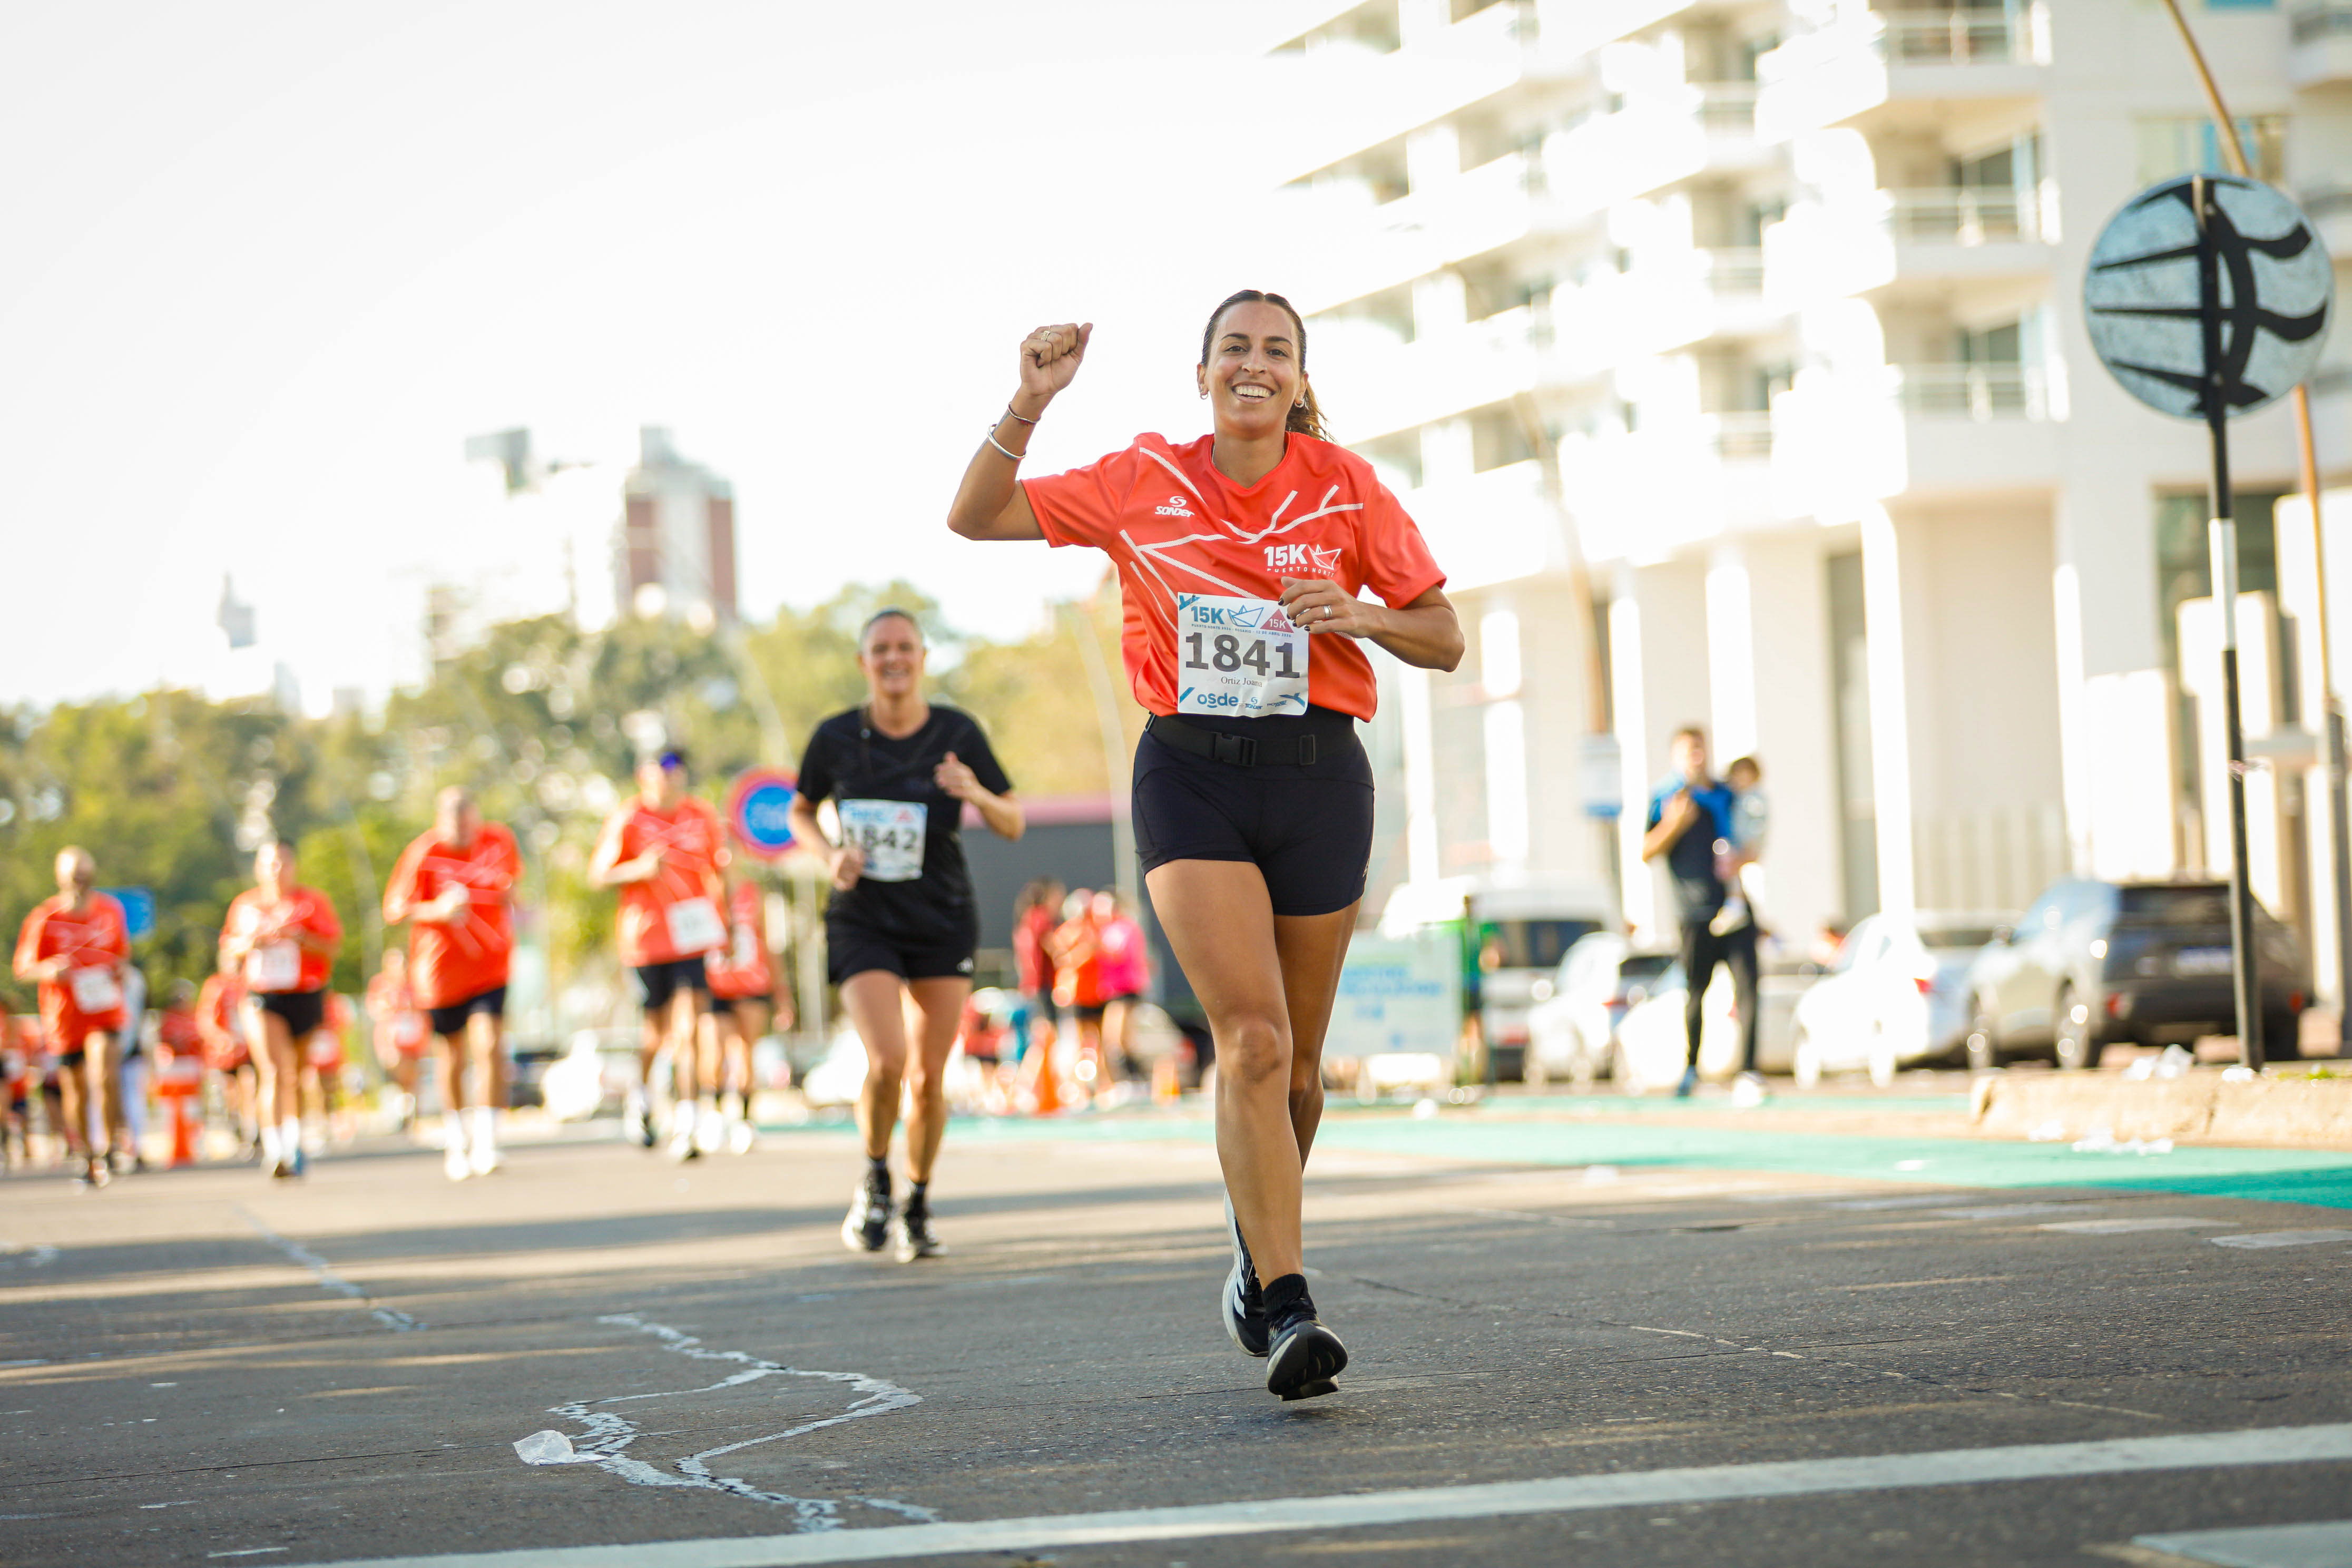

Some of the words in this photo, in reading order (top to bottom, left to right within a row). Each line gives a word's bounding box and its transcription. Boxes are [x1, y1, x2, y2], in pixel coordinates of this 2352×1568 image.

[1264, 544, 1308, 567] 15K
[1312, 567, 1335, 578] NORTE
[1191, 605, 1225, 625] 15K
[1269, 618, 1286, 630] 15K
[1186, 632, 1300, 679] 1841
[1221, 676, 1241, 685] Ortiz
[1242, 678, 1263, 688] Joana
[1197, 692, 1239, 707] osde
[845, 825, 917, 851] 1842
